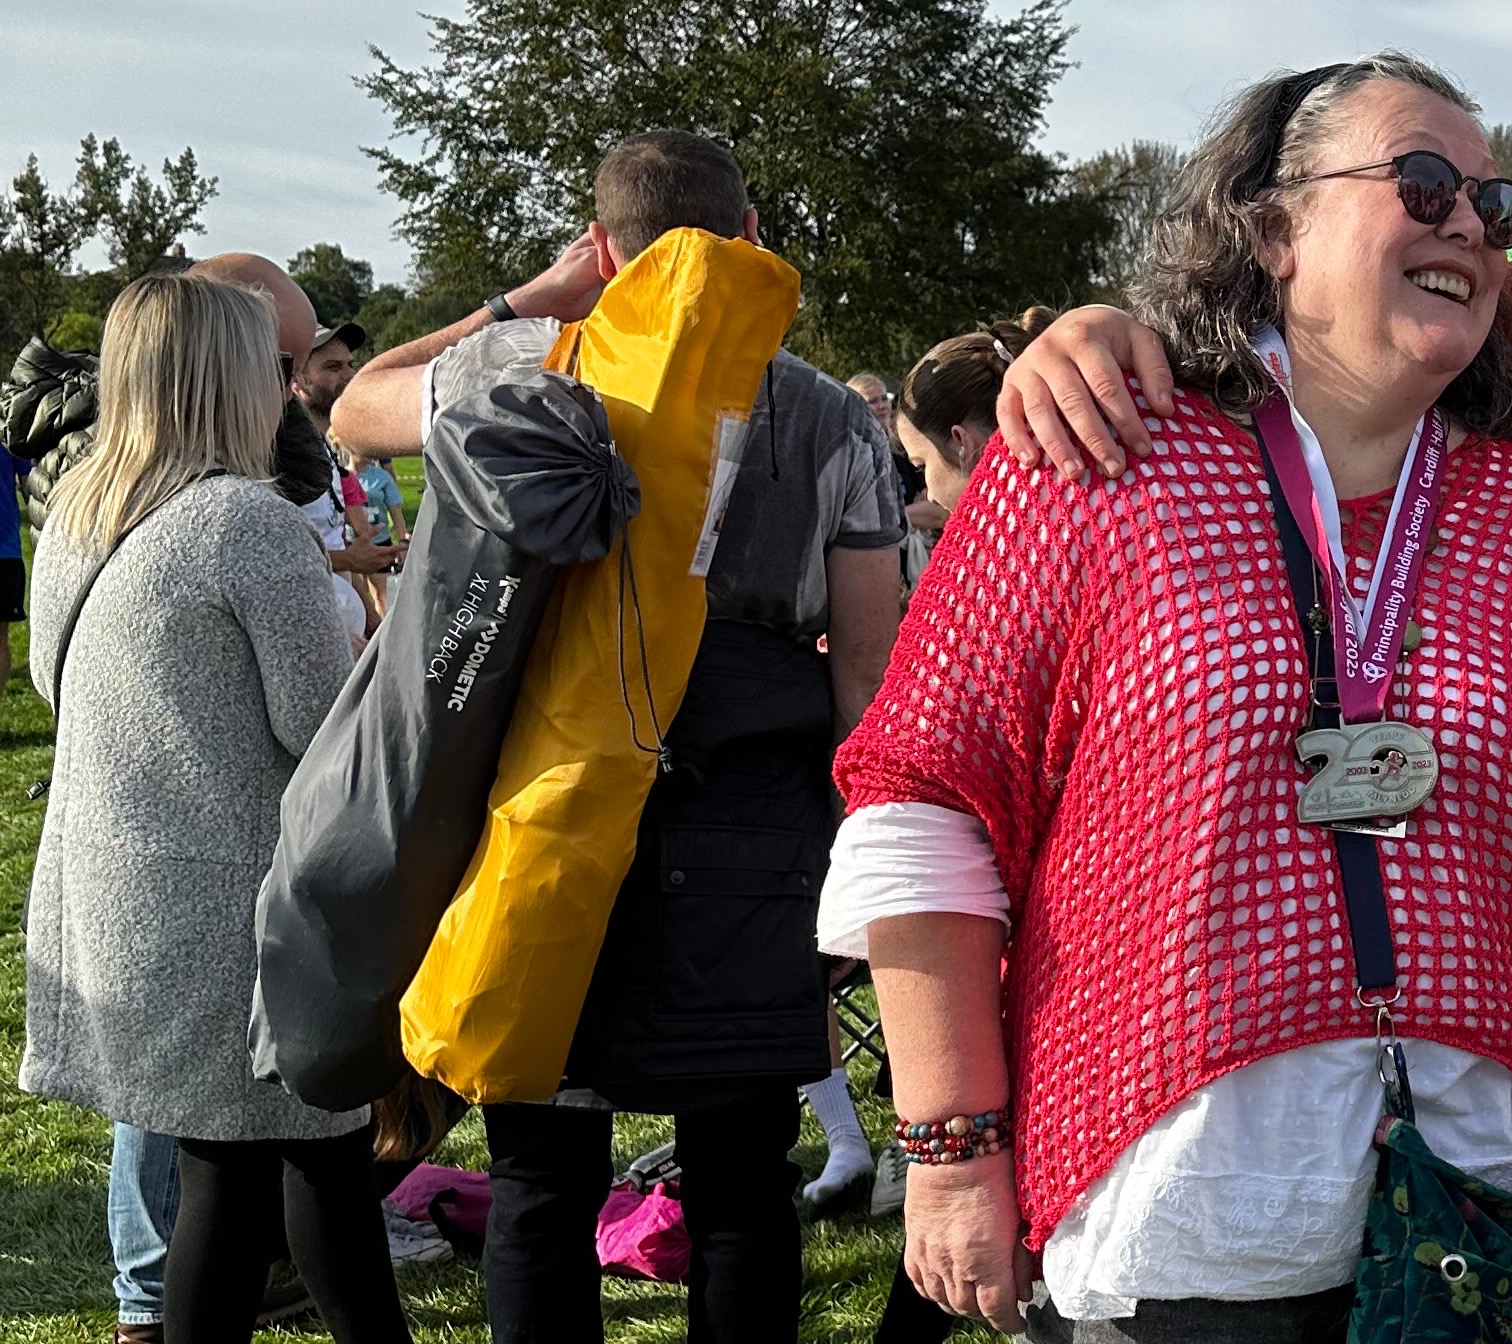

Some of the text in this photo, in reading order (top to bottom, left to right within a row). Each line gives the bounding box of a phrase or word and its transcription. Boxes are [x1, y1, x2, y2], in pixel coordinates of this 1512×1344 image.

[1419, 445, 1441, 488] Cardiff
[1404, 495, 1430, 539] Society
[1391, 540, 1420, 590] Building
[425, 572, 490, 684] XL HIGH BACK
[1372, 590, 1406, 663] Principality
[447, 641, 492, 713] DOMETIC
